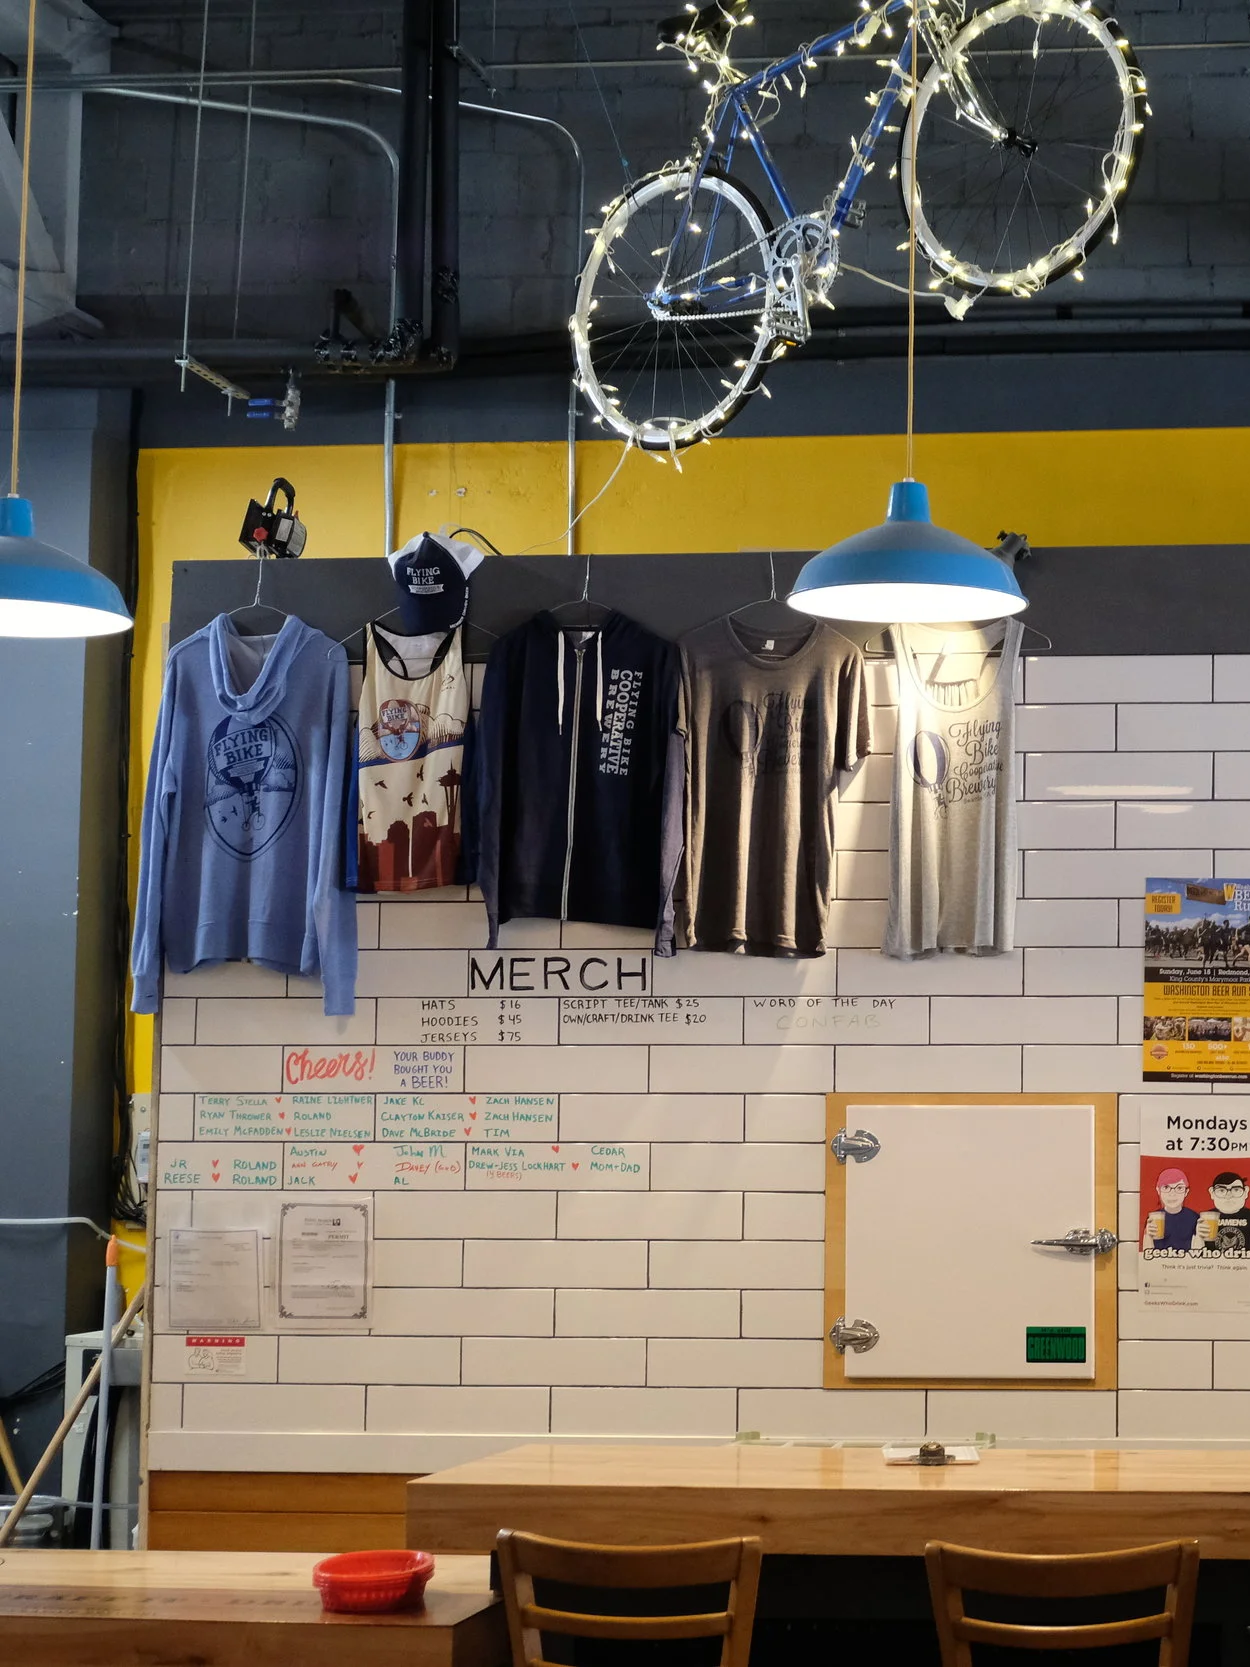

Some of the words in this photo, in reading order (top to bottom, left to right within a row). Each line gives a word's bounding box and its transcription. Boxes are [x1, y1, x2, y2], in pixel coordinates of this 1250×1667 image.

[406, 567, 440, 576] FLYING
[412, 576, 434, 584] BIKE
[626, 671, 643, 729] FLYING
[382, 707, 407, 717] FLYING
[386, 713, 405, 721] BIKE
[599, 669, 620, 773] BREWERY
[606, 670, 633, 774] COOPERATIVE
[949, 720, 1001, 747] Flying
[214, 728, 268, 756] FLYING
[224, 744, 264, 765] BIKE
[619, 738, 632, 776] BIKE
[965, 738, 999, 765] Bike
[470, 957, 648, 991] MERCH
[1159, 968, 1185, 976] Sunday,
[1163, 985, 1210, 996] WASHINGTON
[1212, 985, 1230, 996] BEER
[1231, 986, 1247, 996] RUN
[422, 1000, 456, 1010] HATS
[563, 999, 608, 1010] SCRIPT
[614, 999, 669, 1010] TEE/TANK
[753, 999, 796, 1008] WORD
[806, 999, 822, 1008] OF
[832, 998, 858, 1008] THE
[872, 999, 896, 1009] DAY
[421, 1016, 479, 1027] HOODIES
[563, 1013, 655, 1025] OWN/CRAFT/DRINK
[658, 1013, 679, 1023] TEE
[685, 1014, 707, 1025] $20
[420, 1032, 478, 1044] JERSEYS
[394, 1051, 418, 1061] YOUR
[423, 1051, 455, 1062] BUDDY
[286, 1048, 376, 1084] Cheers!
[394, 1064, 428, 1074] BOUGHT
[432, 1065, 453, 1074] YOU
[400, 1078, 407, 1087] A
[412, 1076, 448, 1088] BEER!
[200, 1096, 230, 1106] TERRY
[292, 1096, 322, 1105] RAINE
[327, 1096, 373, 1105] LIGHTNER
[384, 1096, 406, 1105] JAKE
[486, 1096, 510, 1105] ZACH
[515, 1096, 554, 1106] HANSEN
[200, 1110, 225, 1120] RYAN
[230, 1110, 272, 1120] THROWER
[294, 1111, 332, 1120] ROLAND
[381, 1112, 425, 1121] CLAYTON
[428, 1110, 464, 1121] KAISER
[484, 1112, 510, 1121] ZACH
[512, 1112, 553, 1122] HANSEN
[1167, 1116, 1248, 1133] Mondays
[199, 1127, 229, 1136] EMILY
[294, 1127, 326, 1137] LESLIE
[330, 1127, 371, 1138] NIELSEN
[382, 1128, 404, 1137] DAVE
[484, 1128, 510, 1138] TIM
[1166, 1138, 1183, 1151] at
[290, 1146, 327, 1157] AUSTIN
[472, 1147, 499, 1156] MARK
[505, 1146, 524, 1156] VIA
[591, 1145, 626, 1158] CEDAR
[171, 1159, 187, 1169] JR
[234, 1159, 277, 1170] ROLAND
[522, 1161, 566, 1171] LOCKHART
[164, 1173, 201, 1184] REESE
[233, 1173, 277, 1186] ROLAND
[288, 1176, 315, 1186] JACK
[394, 1176, 409, 1186] AL
[1143, 1246, 1186, 1260] geeks
[1187, 1246, 1222, 1259] who
